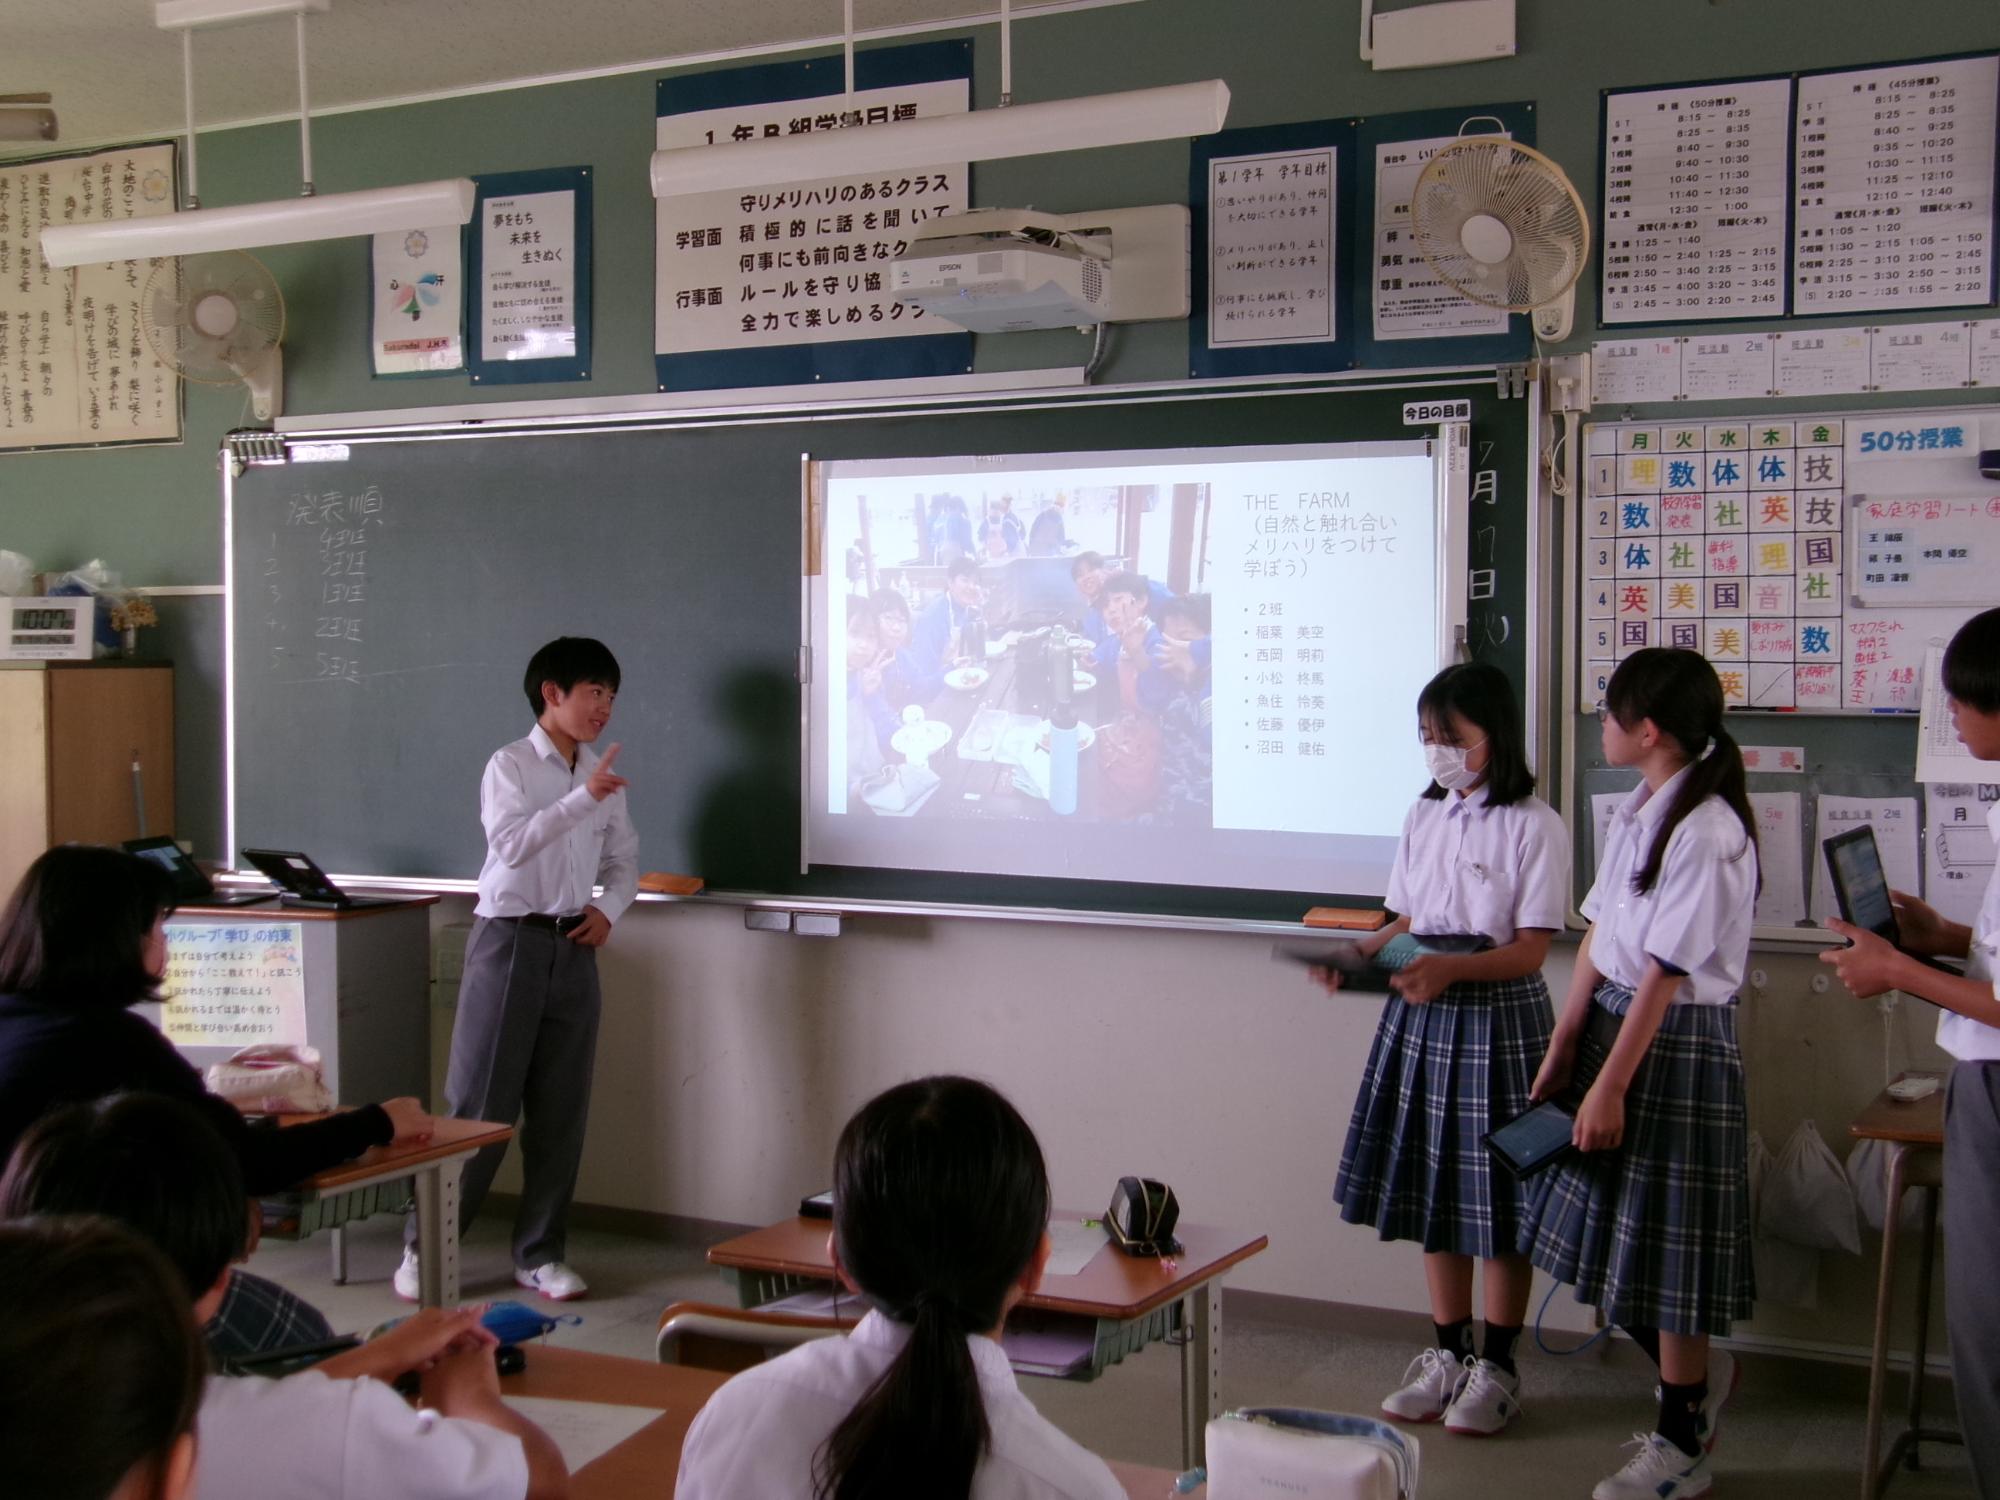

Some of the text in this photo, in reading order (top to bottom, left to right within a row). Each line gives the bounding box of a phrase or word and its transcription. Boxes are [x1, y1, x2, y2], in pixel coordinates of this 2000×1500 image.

[1678, 109, 1750, 122] 8:15 8:25
[1677, 124, 1750, 137] 8:25 8:35
[1874, 121, 1954, 136] 8:40 9:25
[1677, 140, 1749, 152] 8:40 9:30
[1676, 155, 1749, 168] 9:40 10:30
[1867, 154, 1953, 168] 10:30 11:15
[1279, 162, 1327, 179] 学年目標
[1670, 170, 1749, 184] 10:40 11:30
[741, 174, 949, 212] 守りメリハリのあるクラス
[1670, 186, 1748, 198] 11:40 12:30
[1670, 202, 1748, 214] 12:30 1:00
[493, 213, 533, 228] 夢をもち
[510, 231, 541, 245] 未来を
[676, 228, 722, 249] 学習面
[1636, 236, 1700, 247] 1:25 1:40
[1830, 233, 1982, 250] 1:30 2:15 1:05 1:50
[522, 249, 562, 264] 生きぬく
[1635, 247, 1776, 262] 1:50 2:40 1:25 2:15
[939, 263, 961, 271] EPSON
[1634, 263, 1776, 277] 2:50 3:40 2:25 3:15
[1633, 279, 1775, 293] 3:45 4:00 3:20 3:45
[676, 287, 722, 308] 行事面
[1634, 294, 1775, 308] 2:45 3:00 2:20 2:45
[1405, 403, 1468, 420] 今日の目標
[1632, 426, 1829, 449] 月 火 水 木 金
[1860, 427, 1963, 452] 50分授業
[1602, 455, 1832, 488] 1 理 数 体 体 技
[287, 486, 383, 525] 発表順
[1244, 492, 1350, 510] THE FARM
[1600, 497, 1835, 529] 2 数 社 英 技
[1245, 537, 1397, 555] メリハリをつけて
[1600, 552, 1606, 564] 3
[1624, 544, 1650, 569] 体
[1669, 542, 1694, 568] 社
[1760, 543, 1788, 569] 理
[1806, 538, 1832, 564] 国
[1244, 559, 1308, 578] 学ぼう）
[1599, 573, 1830, 612] 4 英 美 国 音 社
[1259, 604, 1282, 616] 2班
[315, 617, 362, 642] 2班
[1257, 626, 1282, 639] 稲葉
[1599, 632, 1606, 645] 5
[1622, 622, 1647, 646] 国
[1672, 624, 1696, 649] 国
[1714, 629, 1740, 654] 美
[1802, 626, 1830, 652] 数
[1257, 649, 1282, 662] 西岡
[1257, 672, 1282, 685] 小松
[1598, 676, 1606, 689] 6
[1257, 740, 1283, 754] 沼田
[1954, 808, 1966, 821] 月
